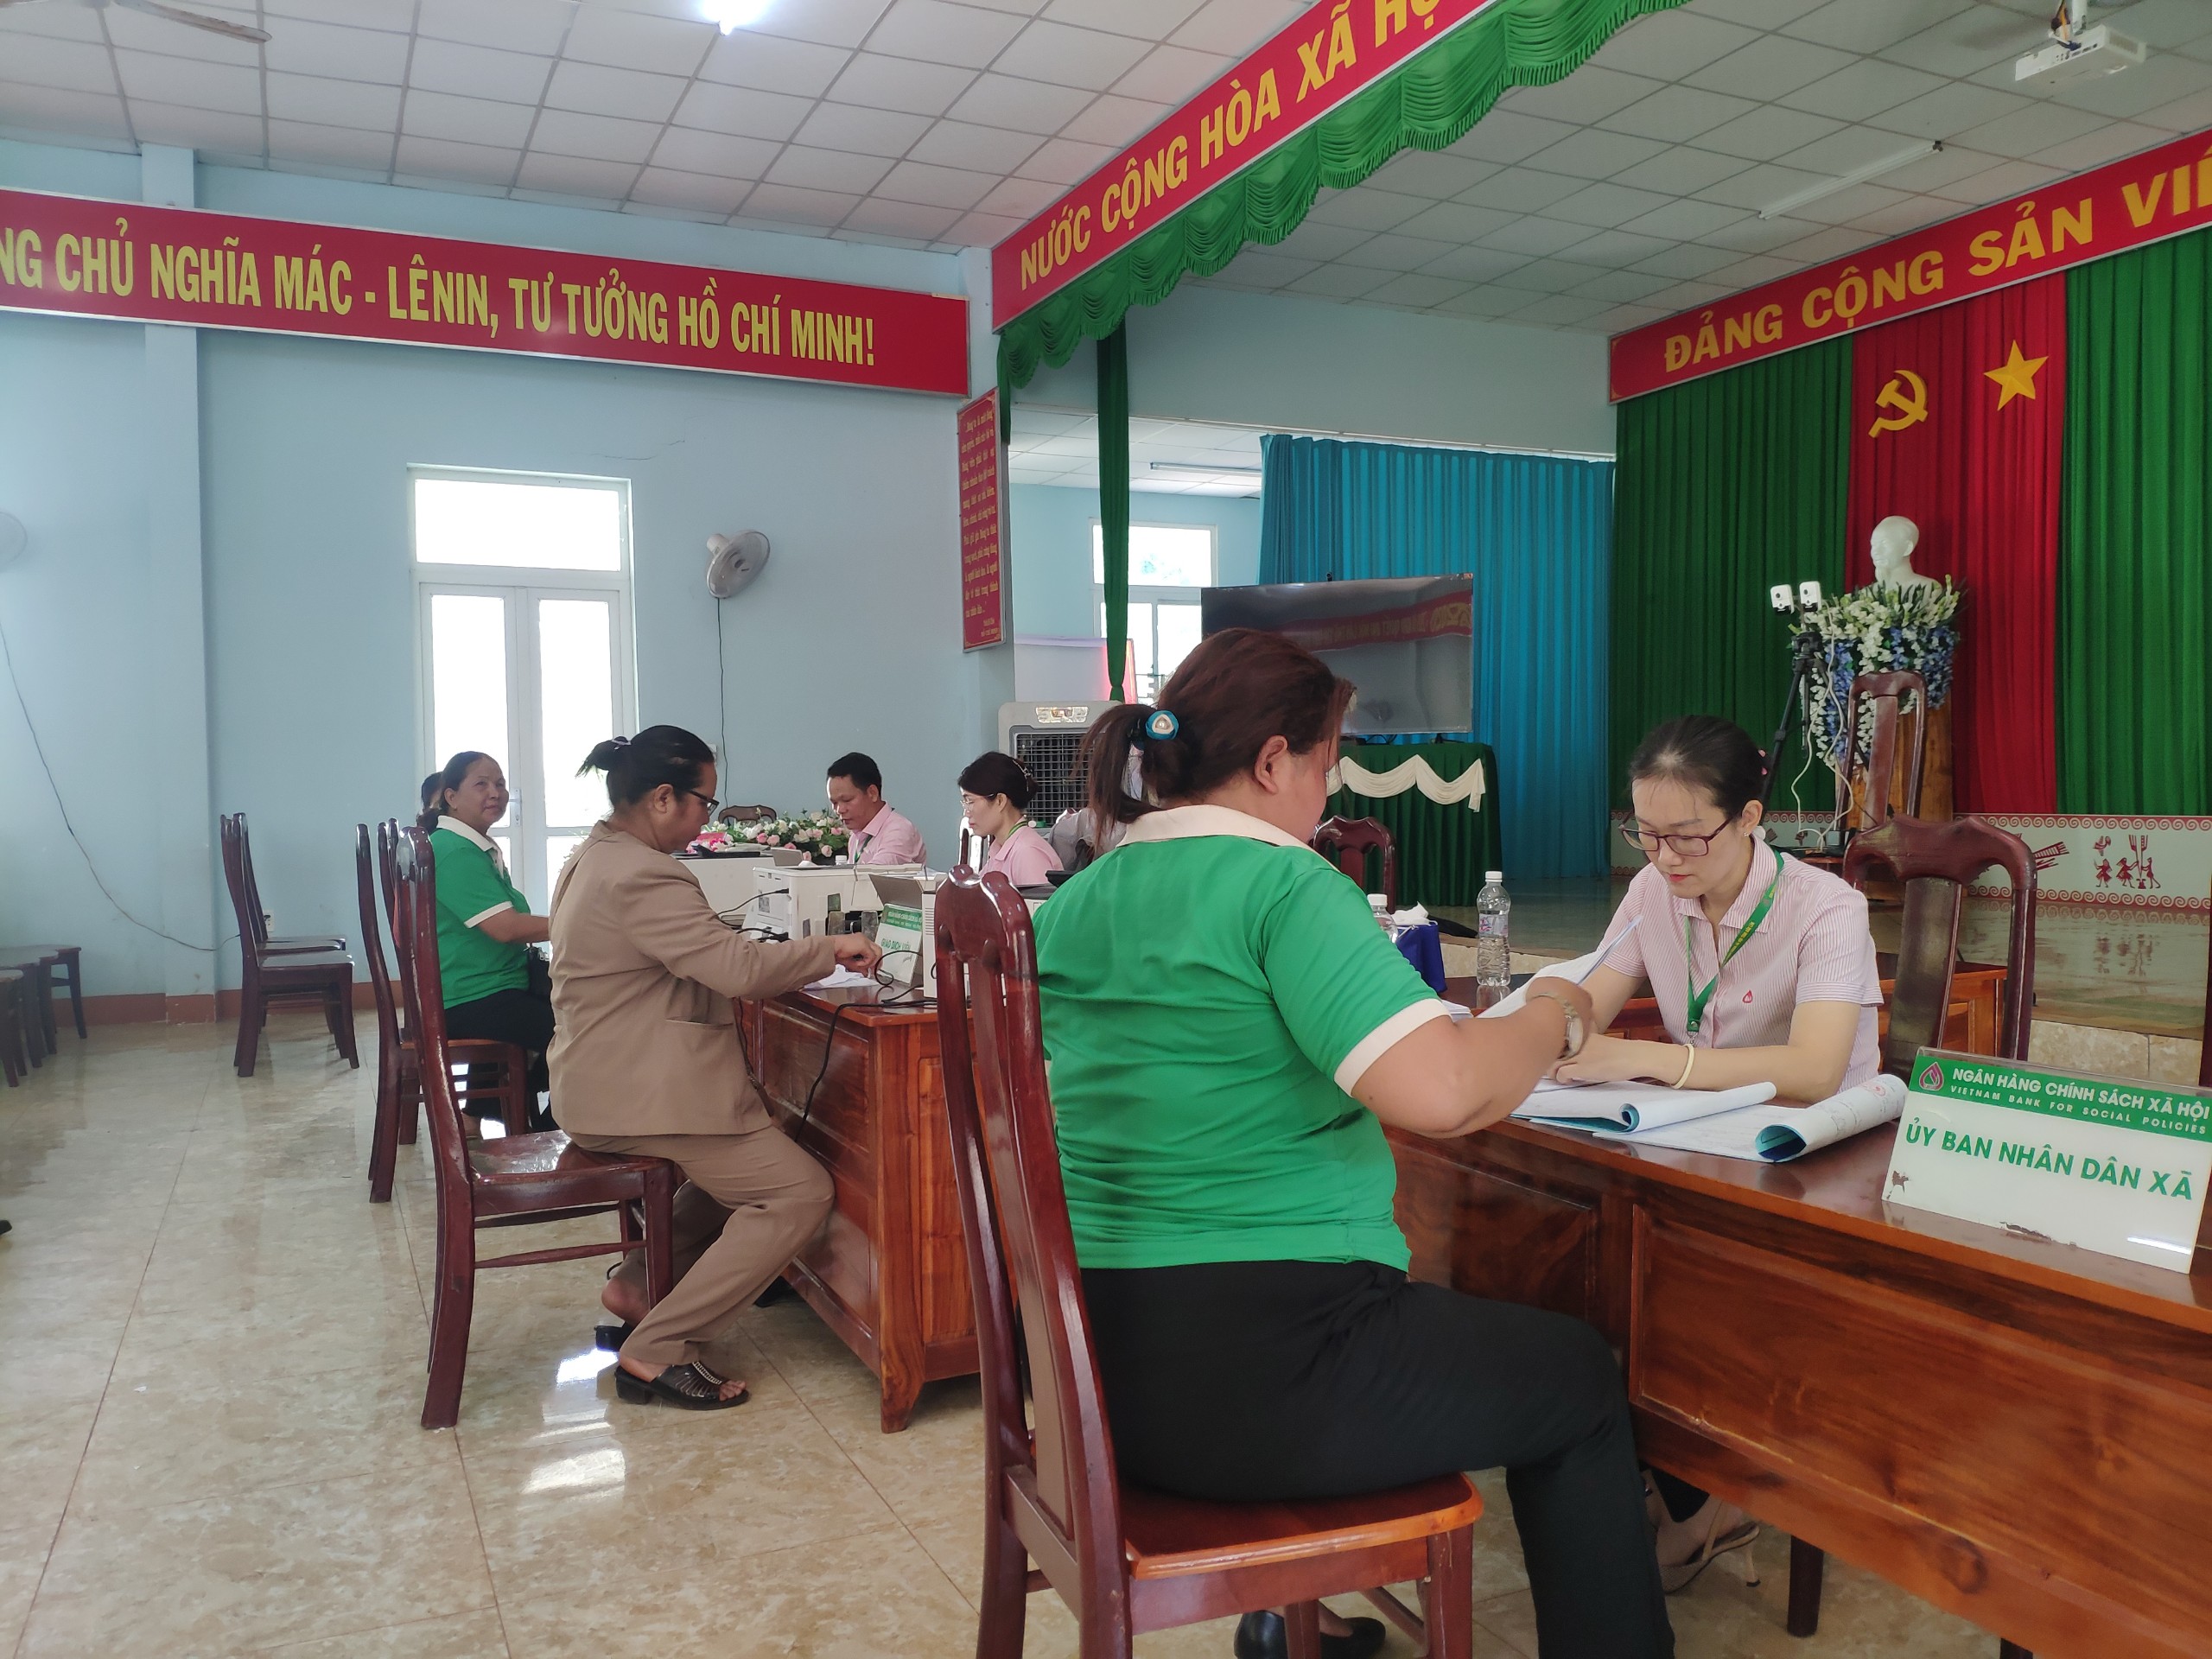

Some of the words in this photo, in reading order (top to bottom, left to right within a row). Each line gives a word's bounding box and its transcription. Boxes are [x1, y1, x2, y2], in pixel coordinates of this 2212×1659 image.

[1021, 205, 1091, 290] NƯỚC
[1101, 135, 1188, 233] CỘNG
[1200, 68, 1281, 168] HÒA
[1296, 0, 1357, 103] XÃ
[55, 217, 134, 296] CHỦ
[150, 236, 262, 307] NGHĨA
[273, 244, 353, 315] MÁC
[388, 253, 499, 338] LÊNIN,
[508, 270, 554, 333] TƯ
[561, 268, 669, 345] TƯỞNG
[678, 276, 720, 349] HỒ
[730, 294, 781, 356] CHÍ
[791, 308, 875, 367] MINH!
[1664, 309, 1783, 372] ĐẢNG
[1802, 251, 1943, 329] CỘNG
[1968, 200, 2093, 276] SẢN
[1950, 1085, 2001, 1101] VIETNAM
[2008, 1095, 2041, 1108] BANK
[2049, 1102, 2074, 1113] FOR
[2082, 1107, 2131, 1122] SOCIAL
[2142, 1116, 2206, 1135] POLICIES
[1953, 1068, 1994, 1086] NGÂN
[1997, 1073, 2041, 1092] HÀNG
[2045, 1082, 2094, 1102] CHÍNH
[2098, 1089, 2144, 1109] SÁCH
[2147, 1096, 2173, 1115] XÃ
[2177, 1100, 2210, 1122] HỘI
[1905, 1116, 1937, 1147] ỦY
[1941, 1130, 1993, 1160] BAN
[1998, 1143, 2075, 1176] NHÂN
[2080, 1155, 2141, 1190] DÂN
[2147, 1170, 2192, 1200] XÃ
